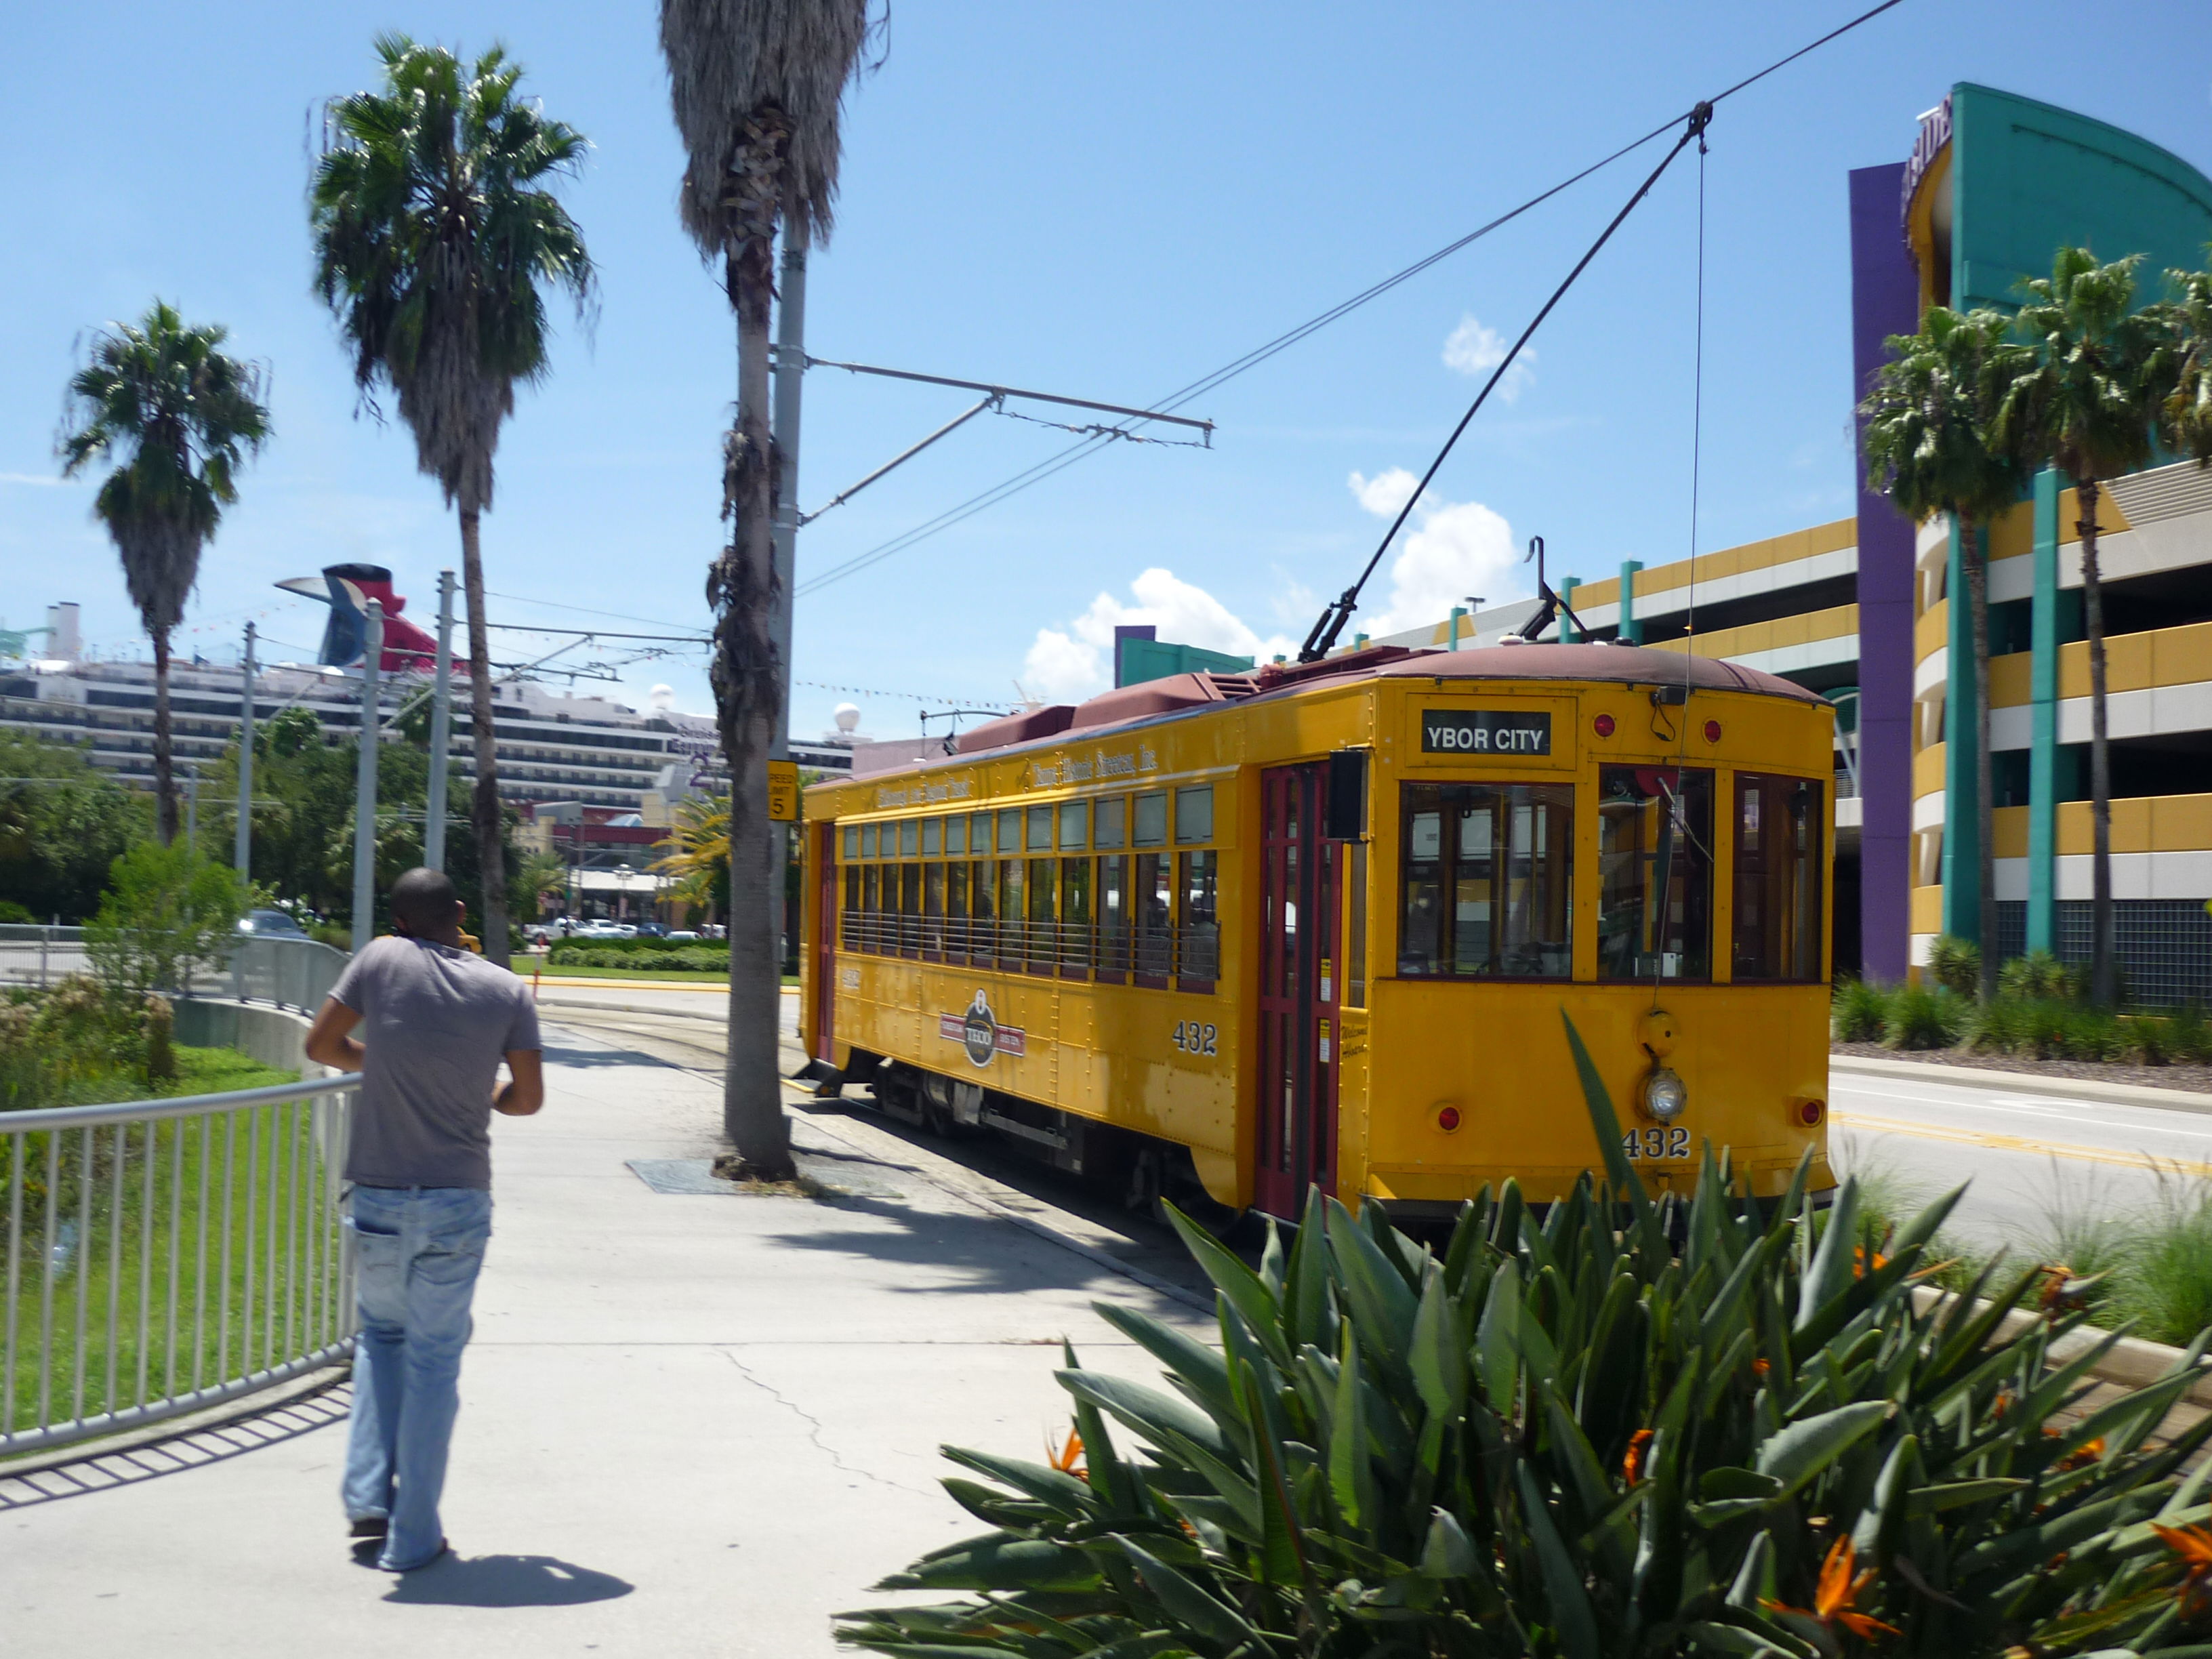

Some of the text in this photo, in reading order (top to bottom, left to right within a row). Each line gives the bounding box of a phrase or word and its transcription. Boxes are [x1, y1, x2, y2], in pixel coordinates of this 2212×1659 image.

[1427, 727, 1543, 750] YBOR CITY
[690, 752, 711, 787] 2
[770, 773, 794, 784] PEED
[772, 798, 784, 815] 5
[1171, 1020, 1217, 1057] 432
[1622, 1127, 1690, 1160] 432
